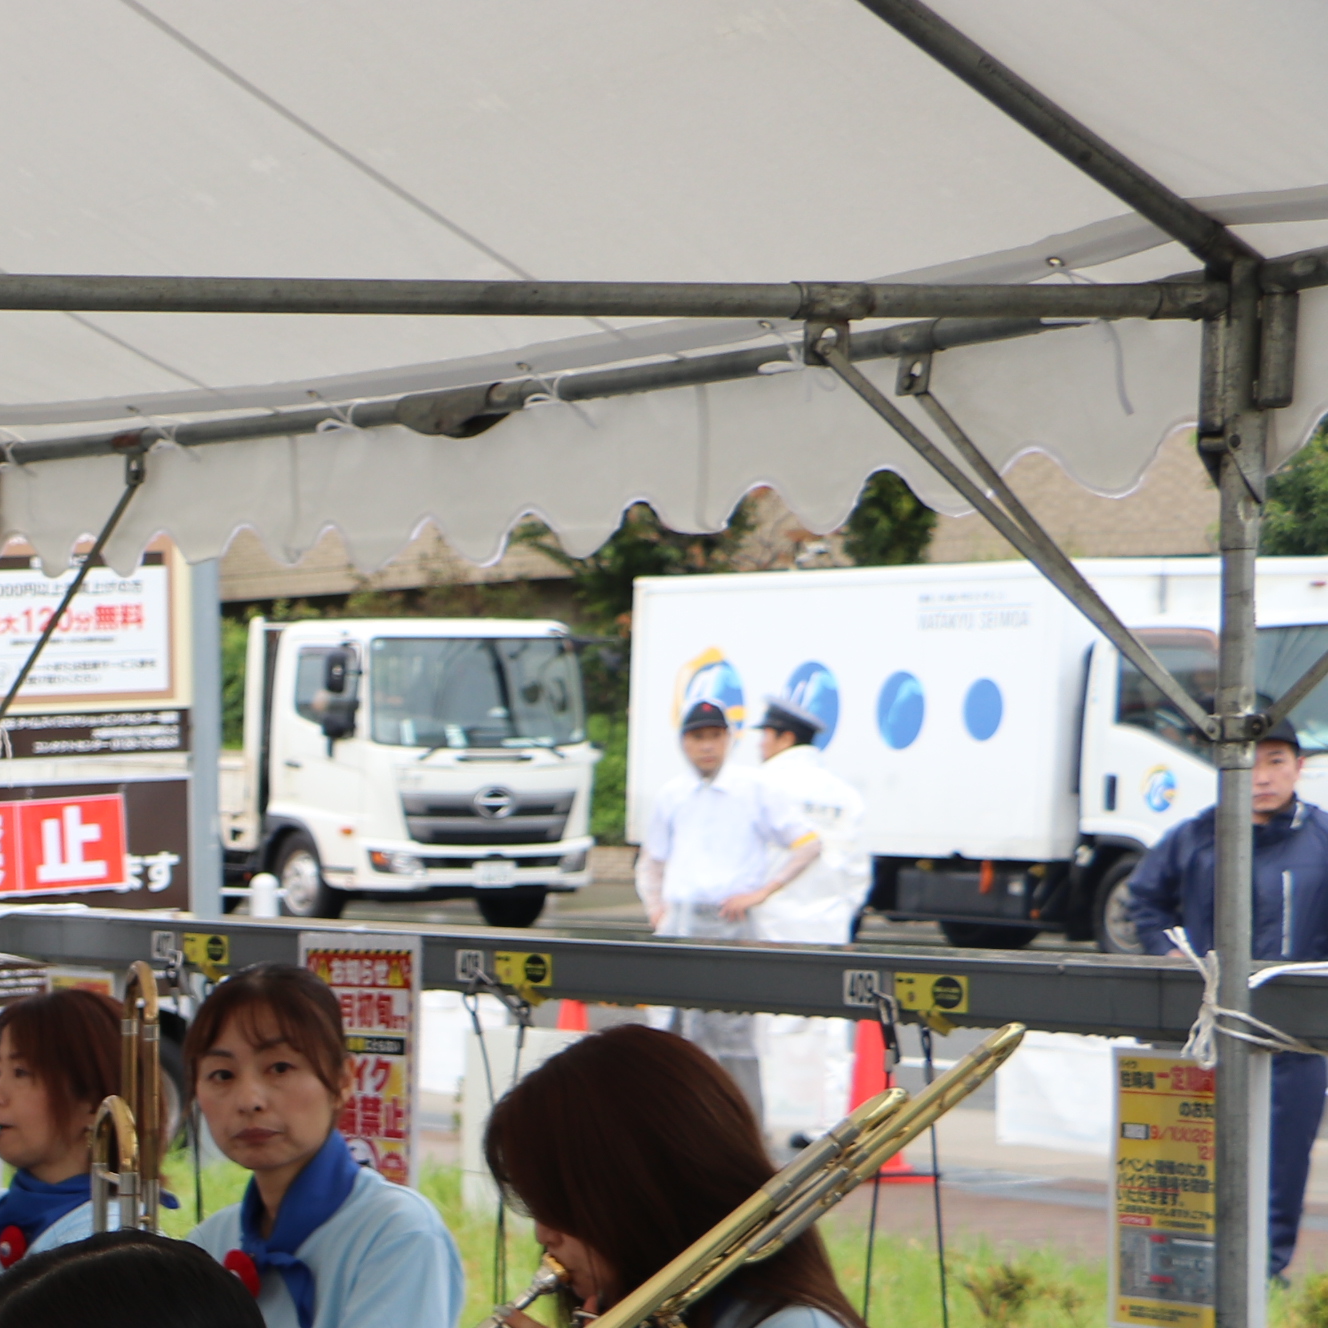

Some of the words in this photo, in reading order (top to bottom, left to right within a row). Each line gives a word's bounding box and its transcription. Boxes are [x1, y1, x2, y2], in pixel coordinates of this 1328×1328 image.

[330, 958, 388, 985] お知らせ
[848, 974, 874, 1000] 409
[355, 1056, 392, 1092] イク
